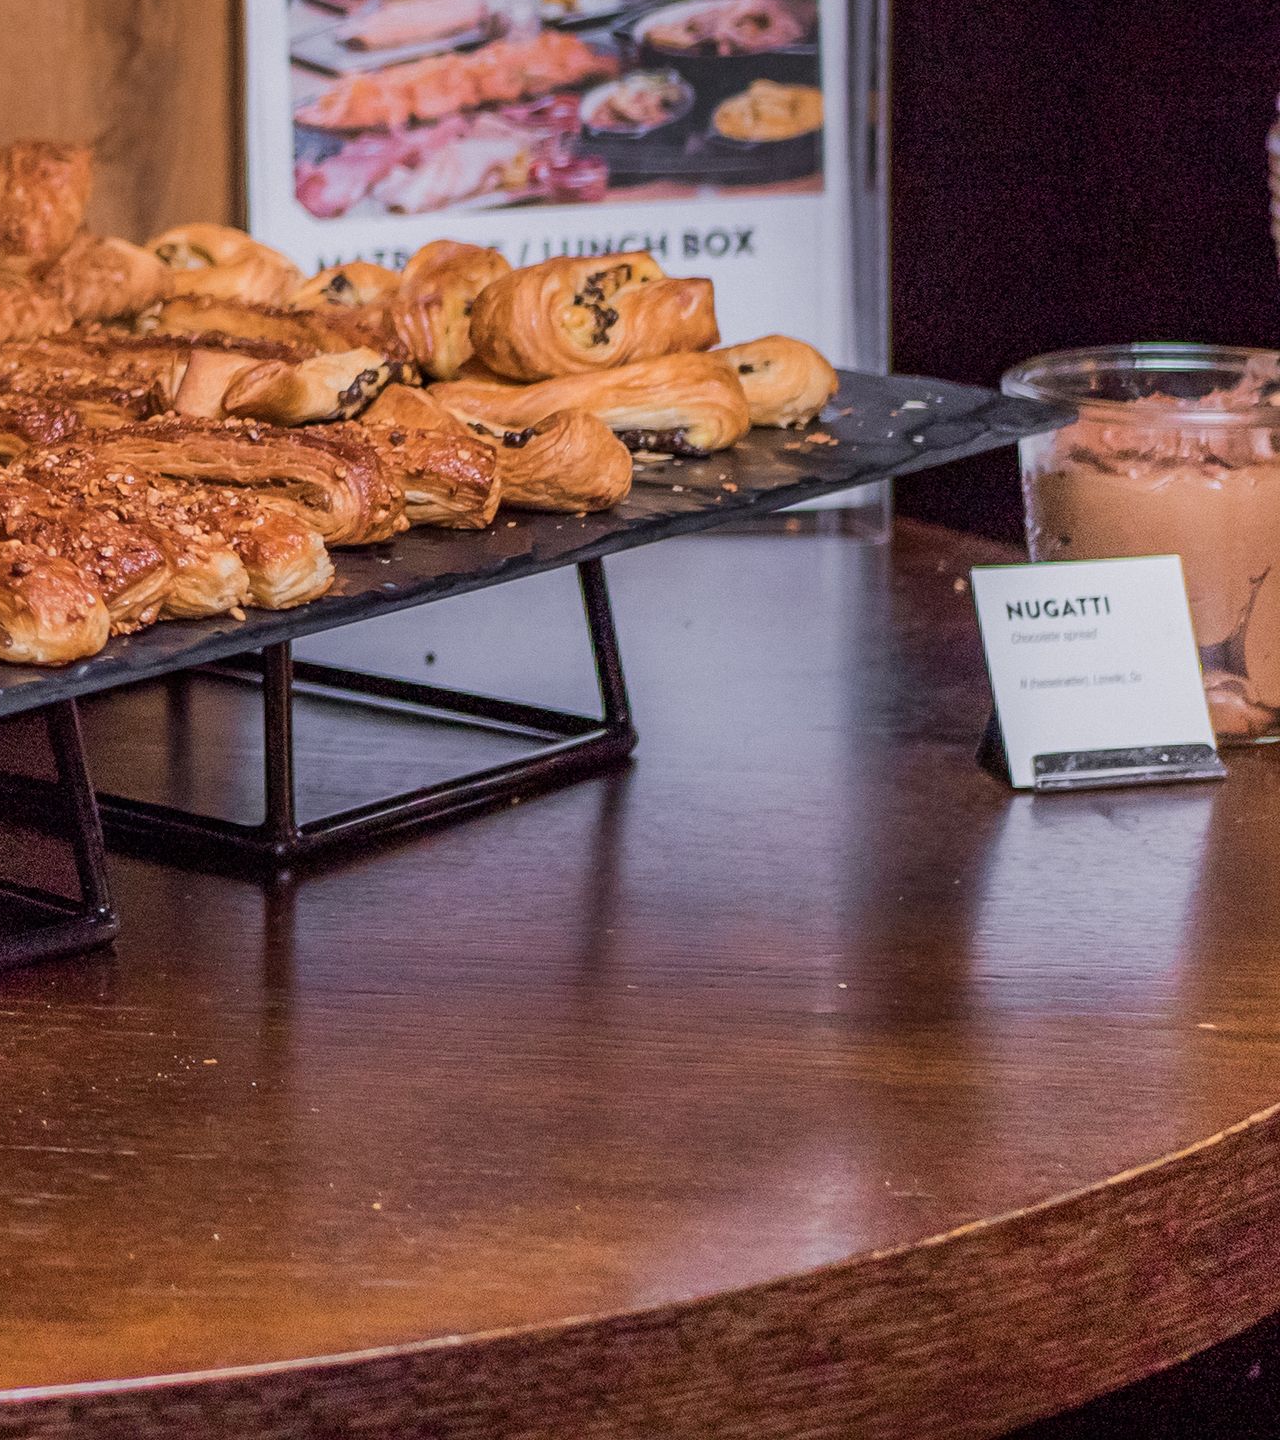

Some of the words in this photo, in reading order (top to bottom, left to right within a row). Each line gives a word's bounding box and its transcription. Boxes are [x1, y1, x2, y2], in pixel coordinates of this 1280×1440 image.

[543, 233, 668, 259] LUNCH
[682, 227, 754, 258] BOX
[1005, 596, 1111, 620] NUGATTI
